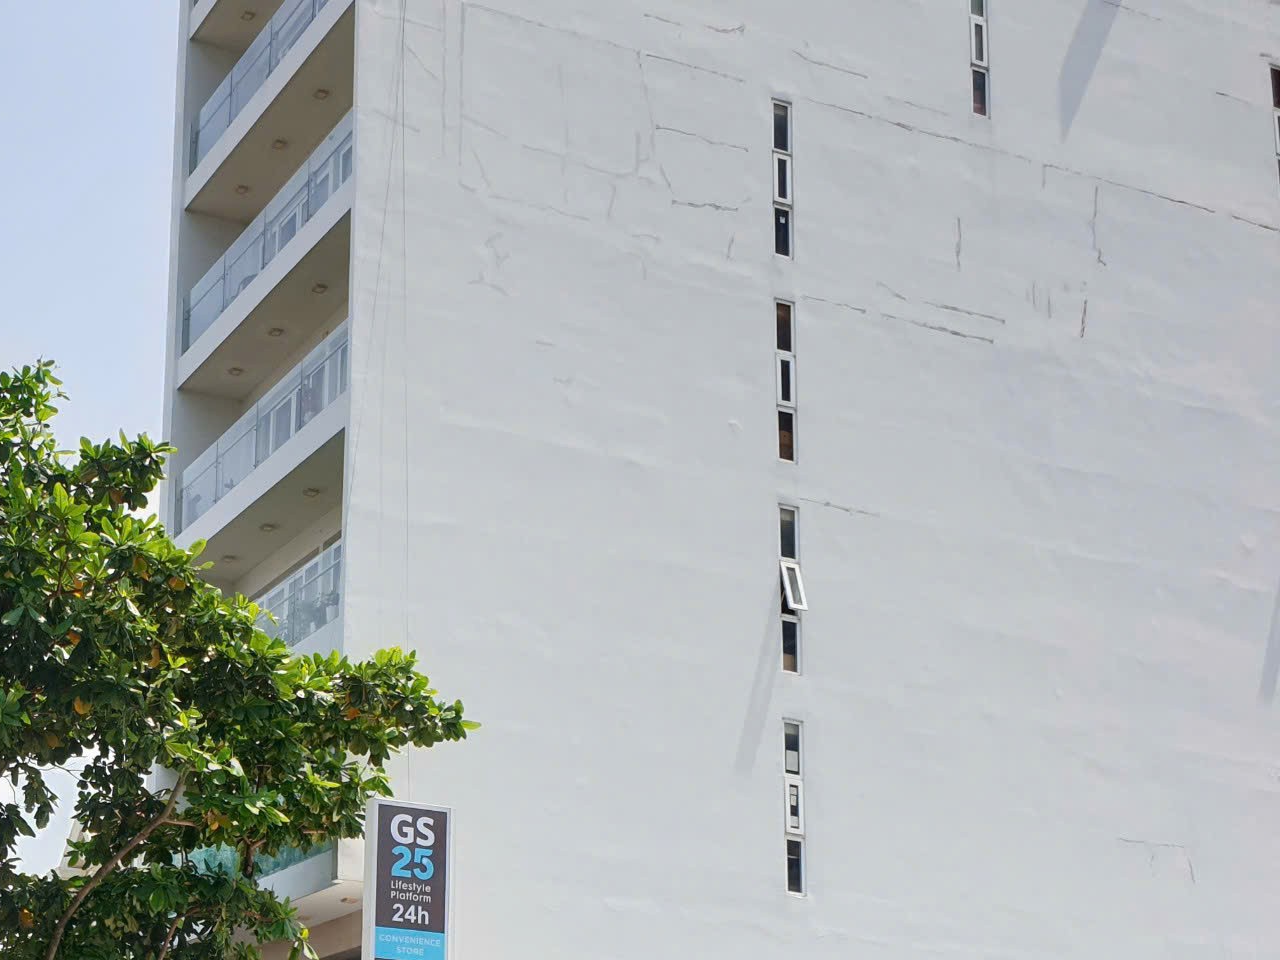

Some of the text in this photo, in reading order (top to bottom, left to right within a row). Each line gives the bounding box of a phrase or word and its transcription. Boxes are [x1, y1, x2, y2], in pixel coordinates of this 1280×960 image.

[390, 813, 436, 847] GS
[391, 845, 434, 881] 25
[390, 880, 432, 894] Lifestyle
[390, 890, 432, 903] Platform
[392, 903, 429, 925] 24h
[395, 945, 425, 957] STORE
